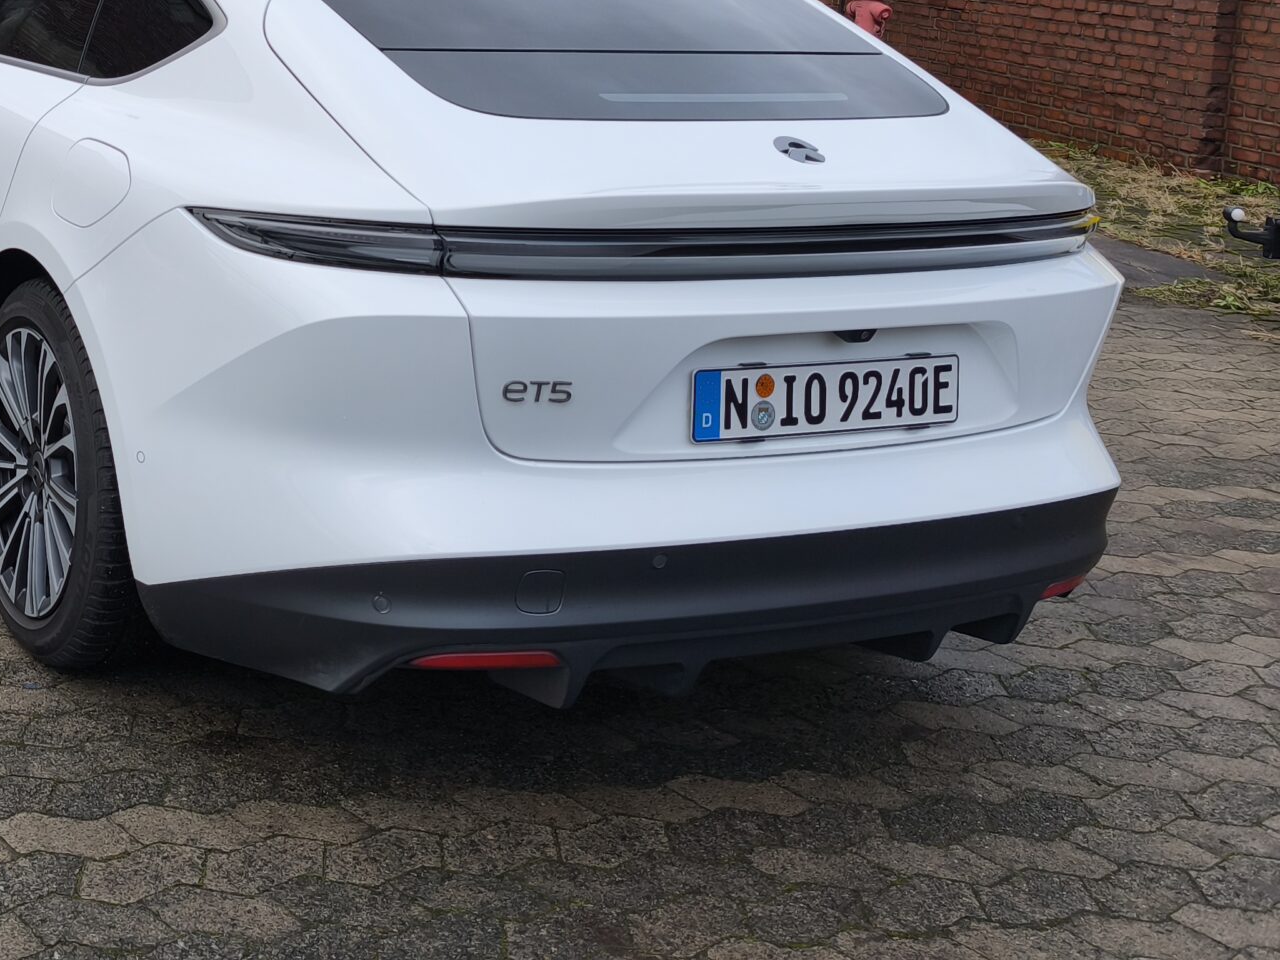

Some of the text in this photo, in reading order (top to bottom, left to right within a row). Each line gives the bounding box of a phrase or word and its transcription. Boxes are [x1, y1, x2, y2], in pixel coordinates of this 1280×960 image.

[724, 377, 749, 430] N
[838, 364, 953, 423] 9240E
[702, 413, 713, 428] D
